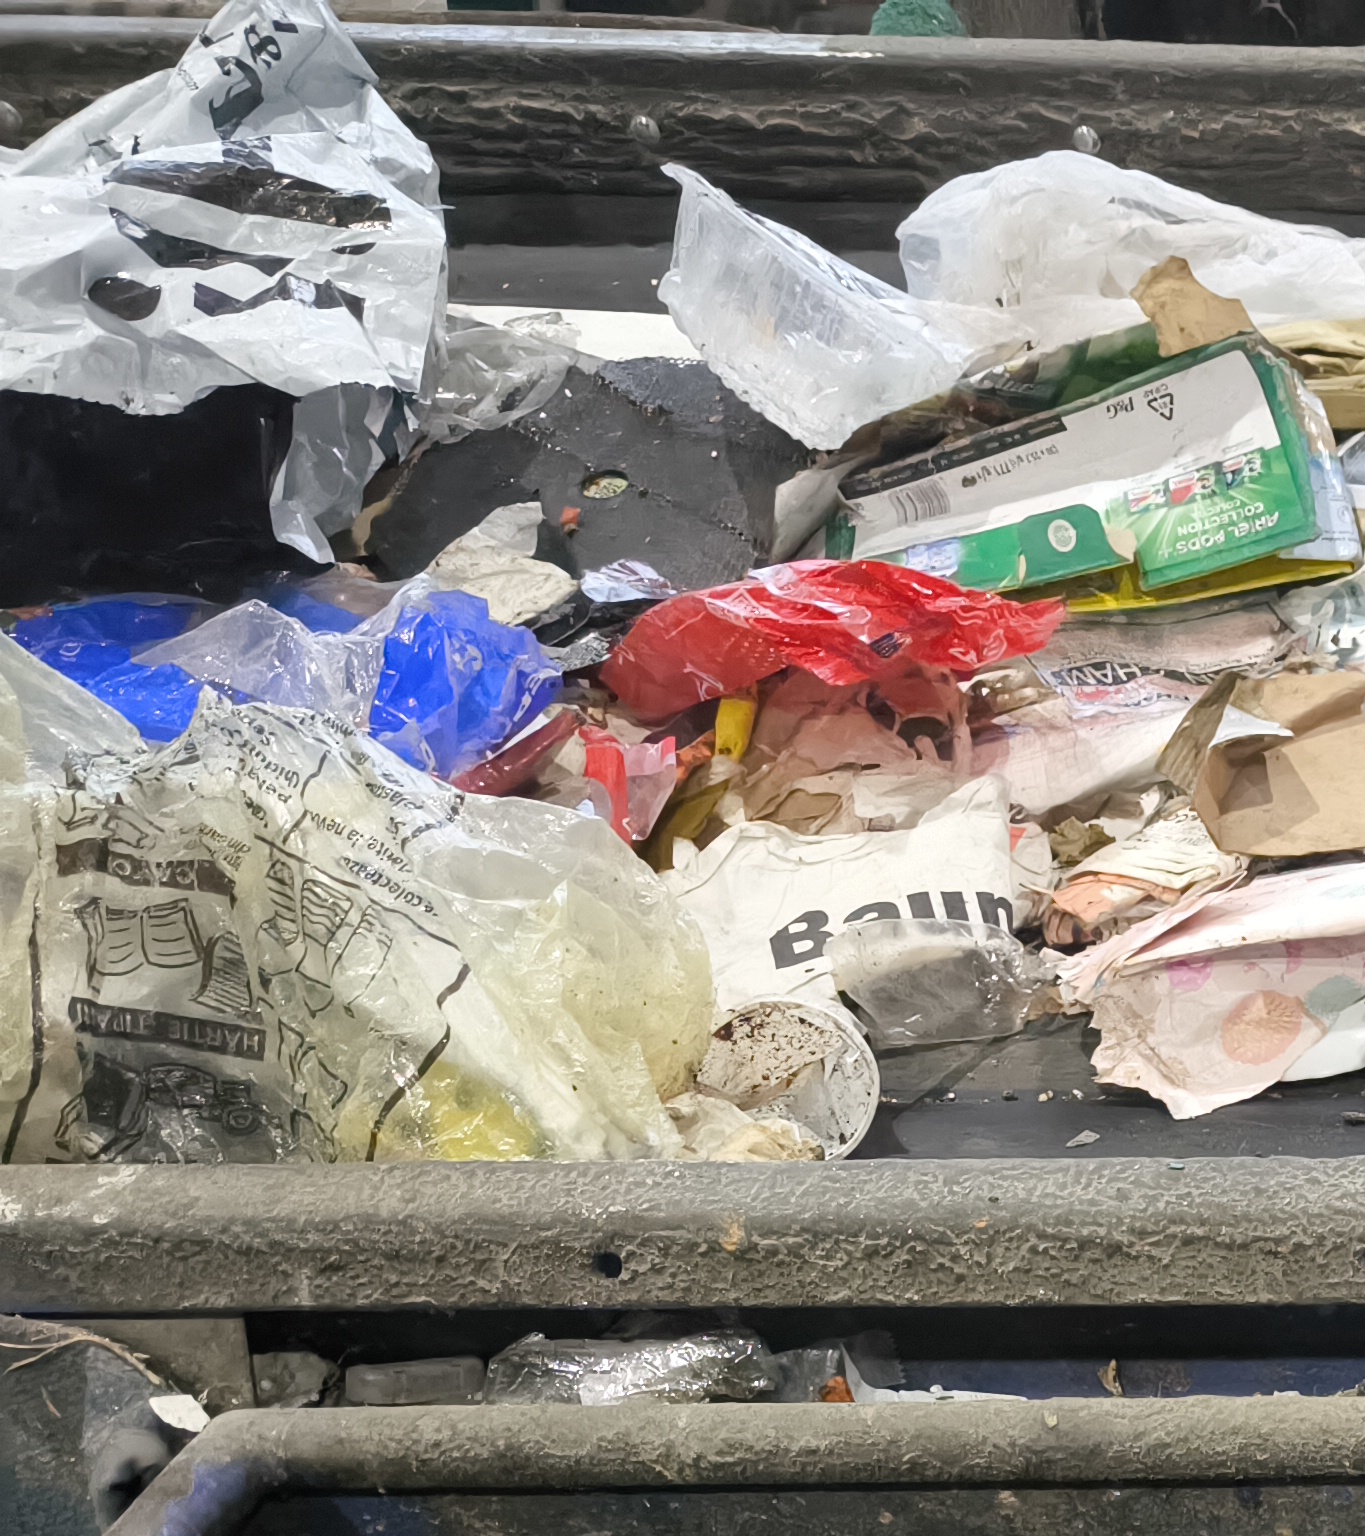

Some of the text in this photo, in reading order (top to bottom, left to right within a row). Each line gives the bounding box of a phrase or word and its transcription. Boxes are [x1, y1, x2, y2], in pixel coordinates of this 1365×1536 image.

[1106, 396, 1135, 420] P&G
[1177, 501, 1264, 538] COLLECTION
[1228, 511, 1280, 539] ARIEL
[1065, 662, 1142, 686] HAM
